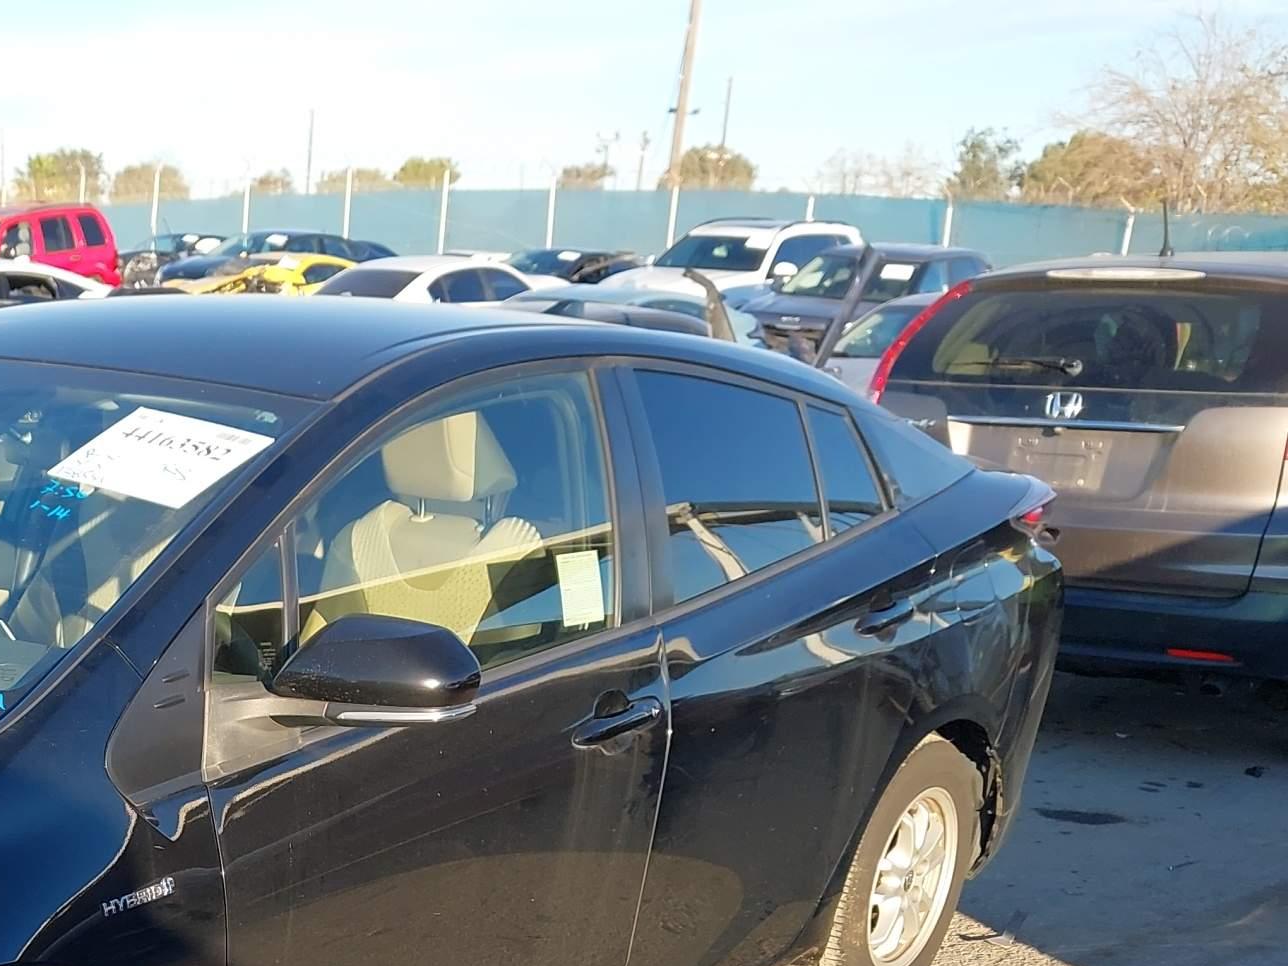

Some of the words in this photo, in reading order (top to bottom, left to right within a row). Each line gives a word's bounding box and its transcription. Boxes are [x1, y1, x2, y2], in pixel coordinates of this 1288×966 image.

[121, 425, 233, 462] 44163582
[29, 500, 72, 519] 1-14
[101, 883, 163, 918] HYBRID
